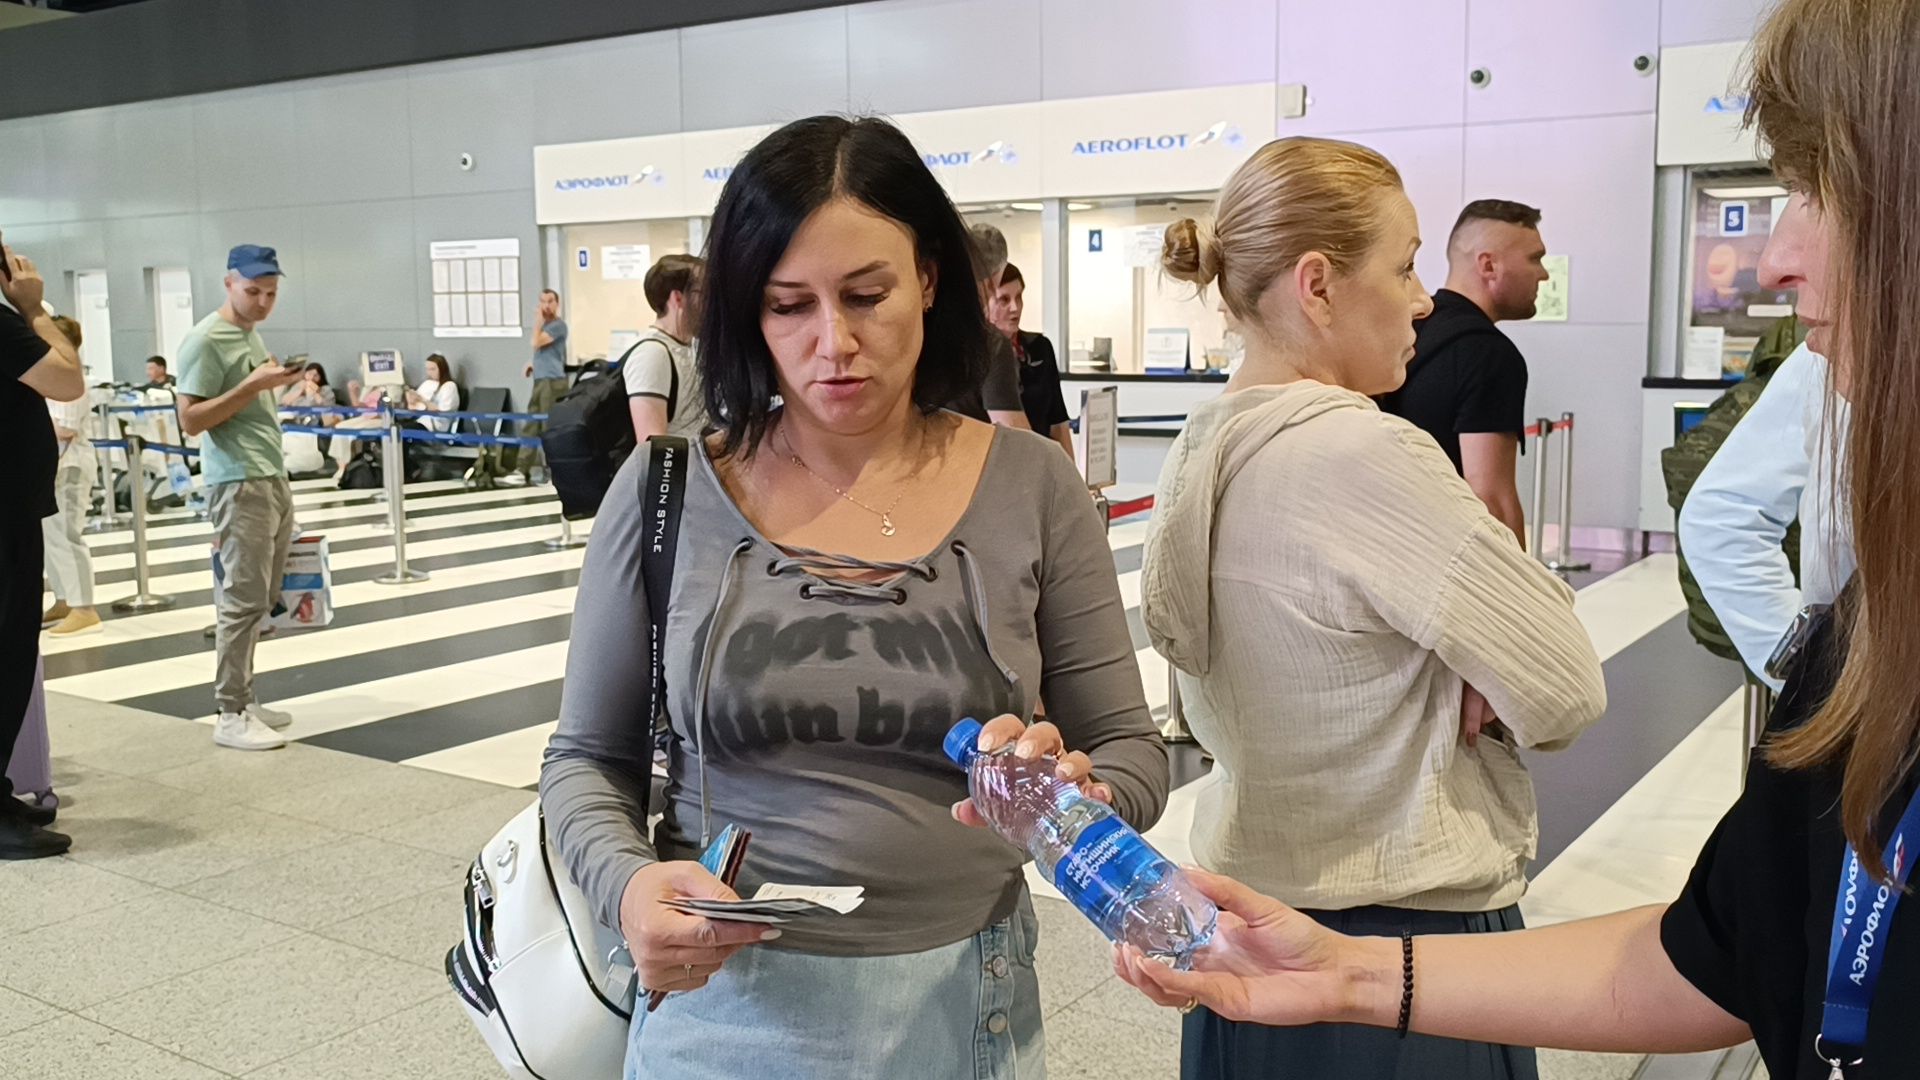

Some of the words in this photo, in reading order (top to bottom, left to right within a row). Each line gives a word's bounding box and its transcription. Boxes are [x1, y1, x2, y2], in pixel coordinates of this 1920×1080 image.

[1072, 133, 1190, 155] AEROFLOT
[554, 174, 630, 190] АЭРОФЛОТ
[1727, 210, 1741, 228] 5
[1090, 232, 1101, 249] 4
[658, 447, 674, 504] FASHION
[653, 509, 667, 553] STYLE
